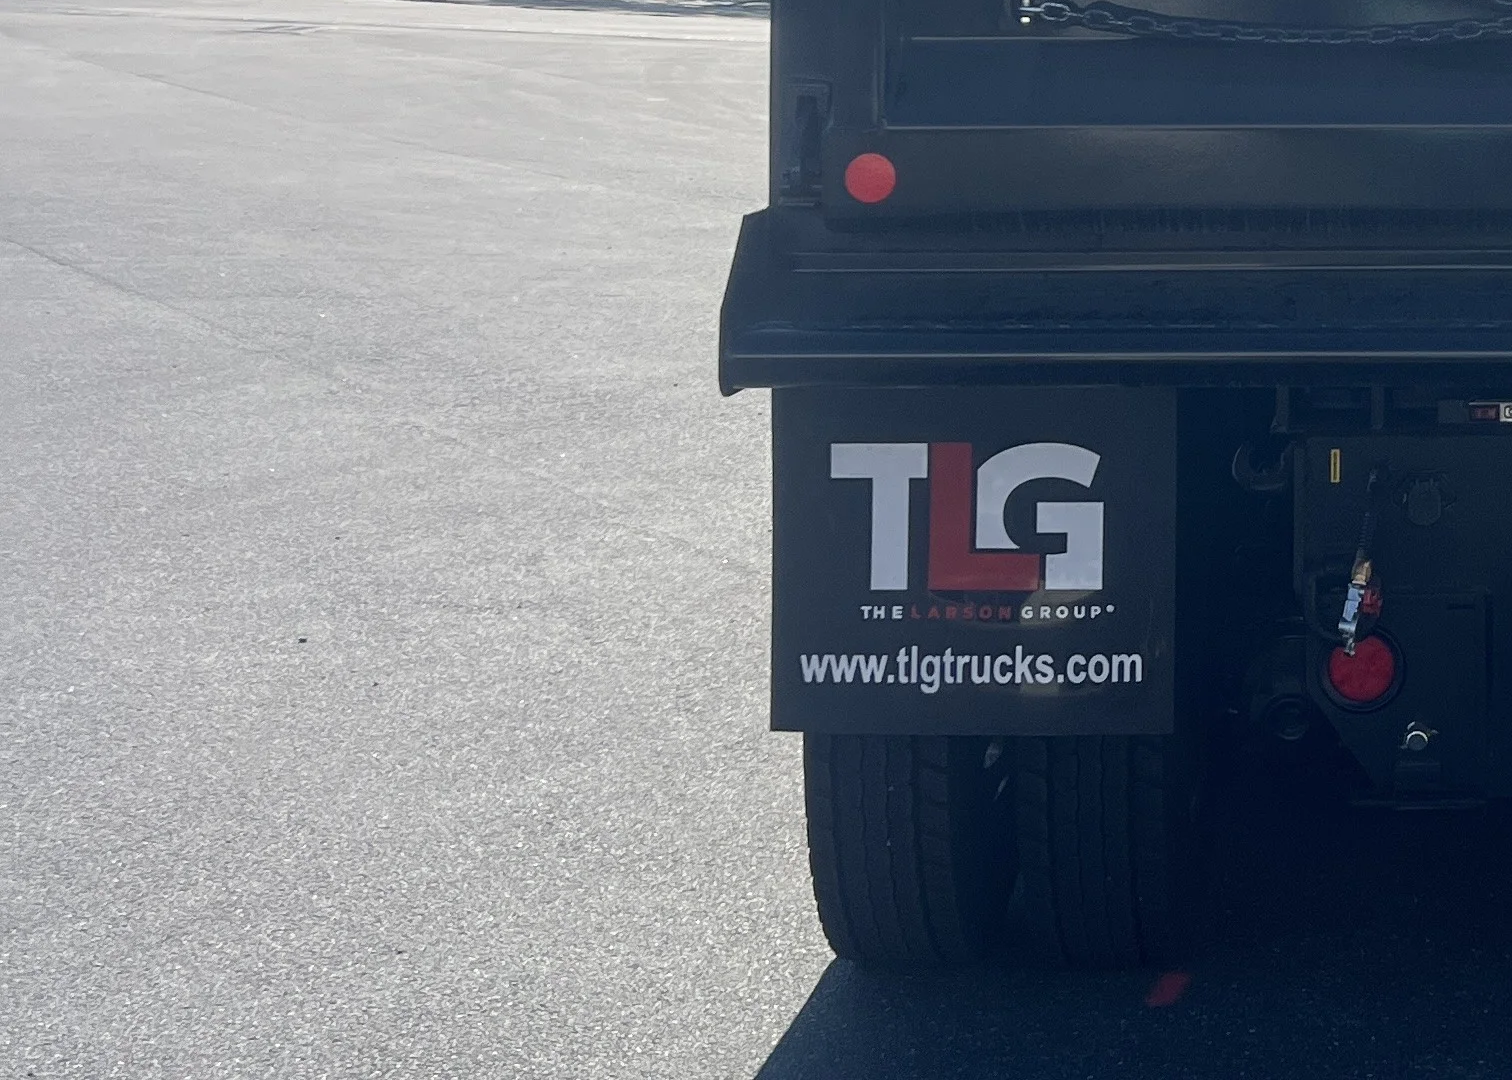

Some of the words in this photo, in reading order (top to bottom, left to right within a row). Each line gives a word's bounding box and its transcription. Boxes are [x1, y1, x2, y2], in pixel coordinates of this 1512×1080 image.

[831, 442, 1104, 591] TLG
[861, 605, 904, 620] THE
[911, 605, 1013, 621] LARSON
[800, 645, 1143, 694] www.tlgtrucks.com
